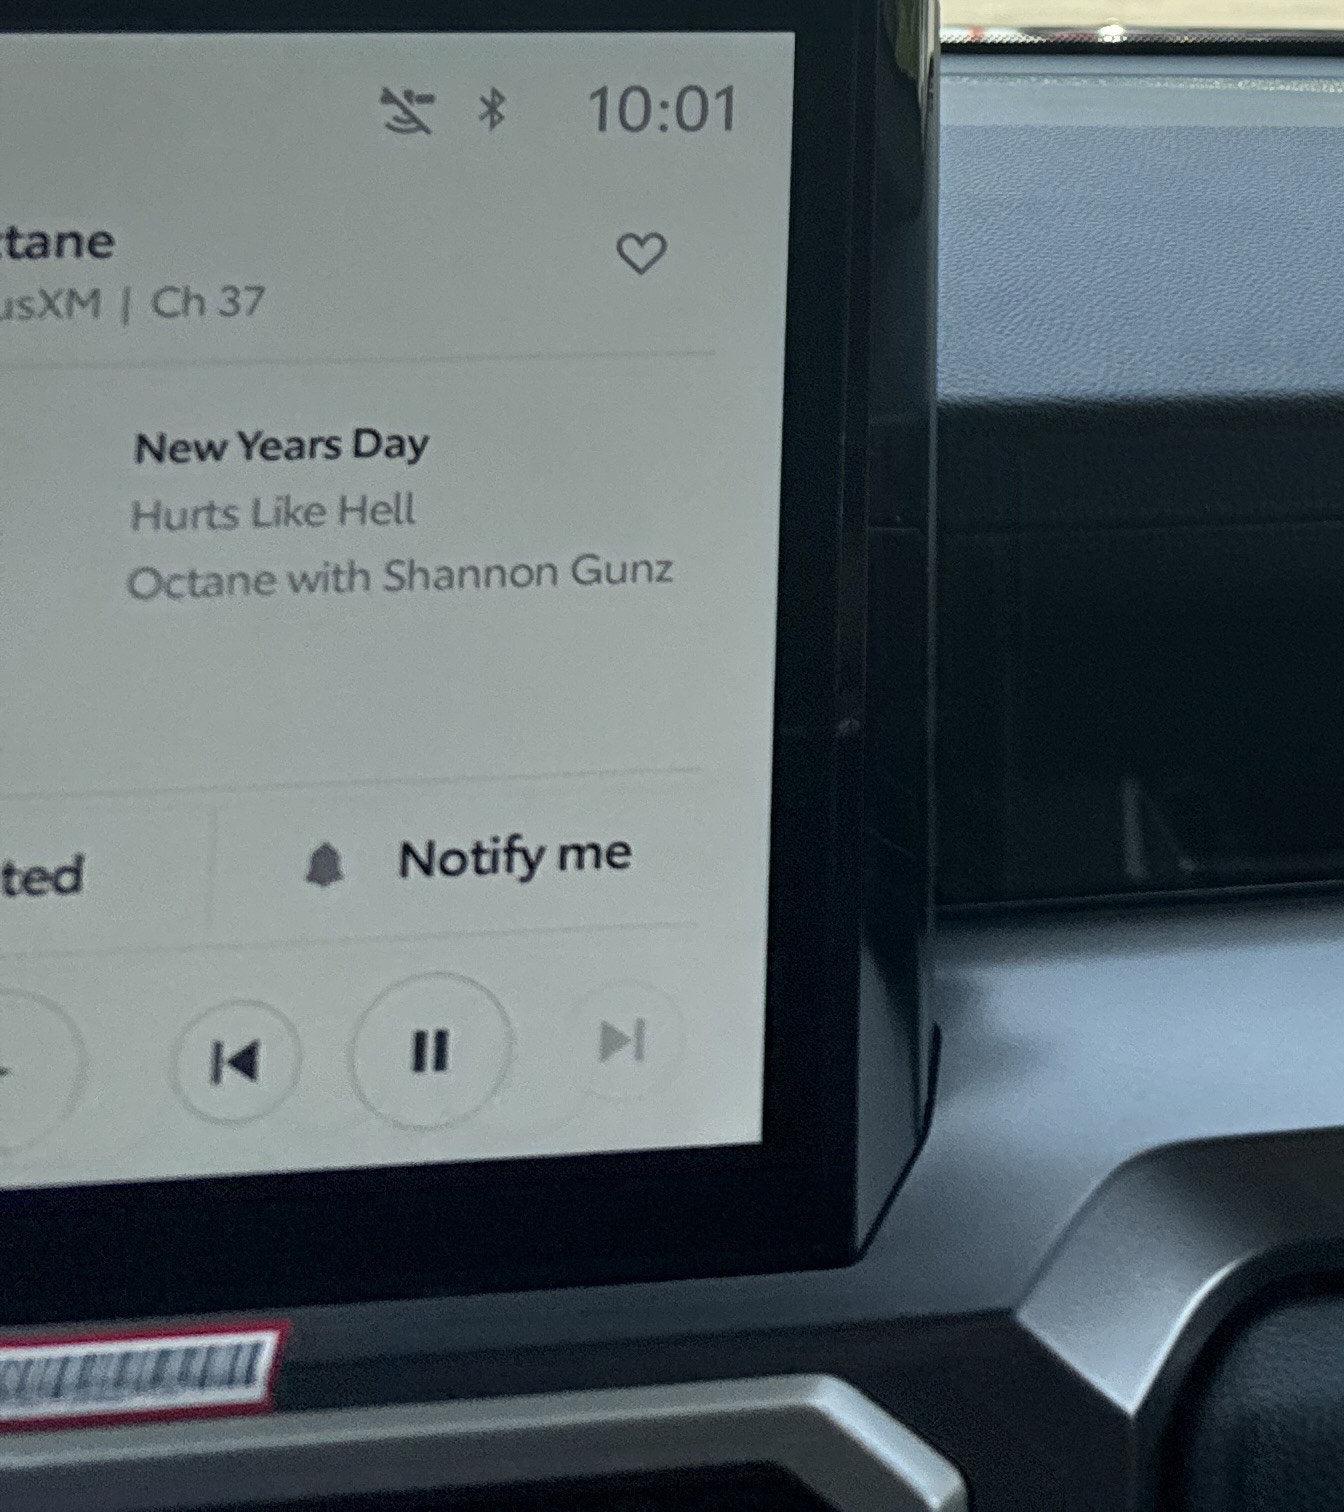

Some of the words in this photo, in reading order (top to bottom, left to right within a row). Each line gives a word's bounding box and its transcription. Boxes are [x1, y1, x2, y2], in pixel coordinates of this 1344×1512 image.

[590, 84, 734, 133] 10:01
[0, 225, 116, 259] tane
[151, 285, 206, 319] Ch
[218, 284, 266, 318] 37
[134, 431, 229, 464] New
[236, 429, 343, 462] Years
[353, 427, 430, 465] Day
[131, 499, 240, 532] Hurts
[251, 493, 328, 528] Like
[339, 491, 417, 526] Hell
[127, 565, 278, 600] Octane
[287, 559, 372, 594] with
[383, 556, 559, 592] Shannon
[571, 552, 674, 586] Gunz
[1, 852, 85, 897] ted
[399, 832, 547, 884] Notify
[559, 840, 634, 872] me
